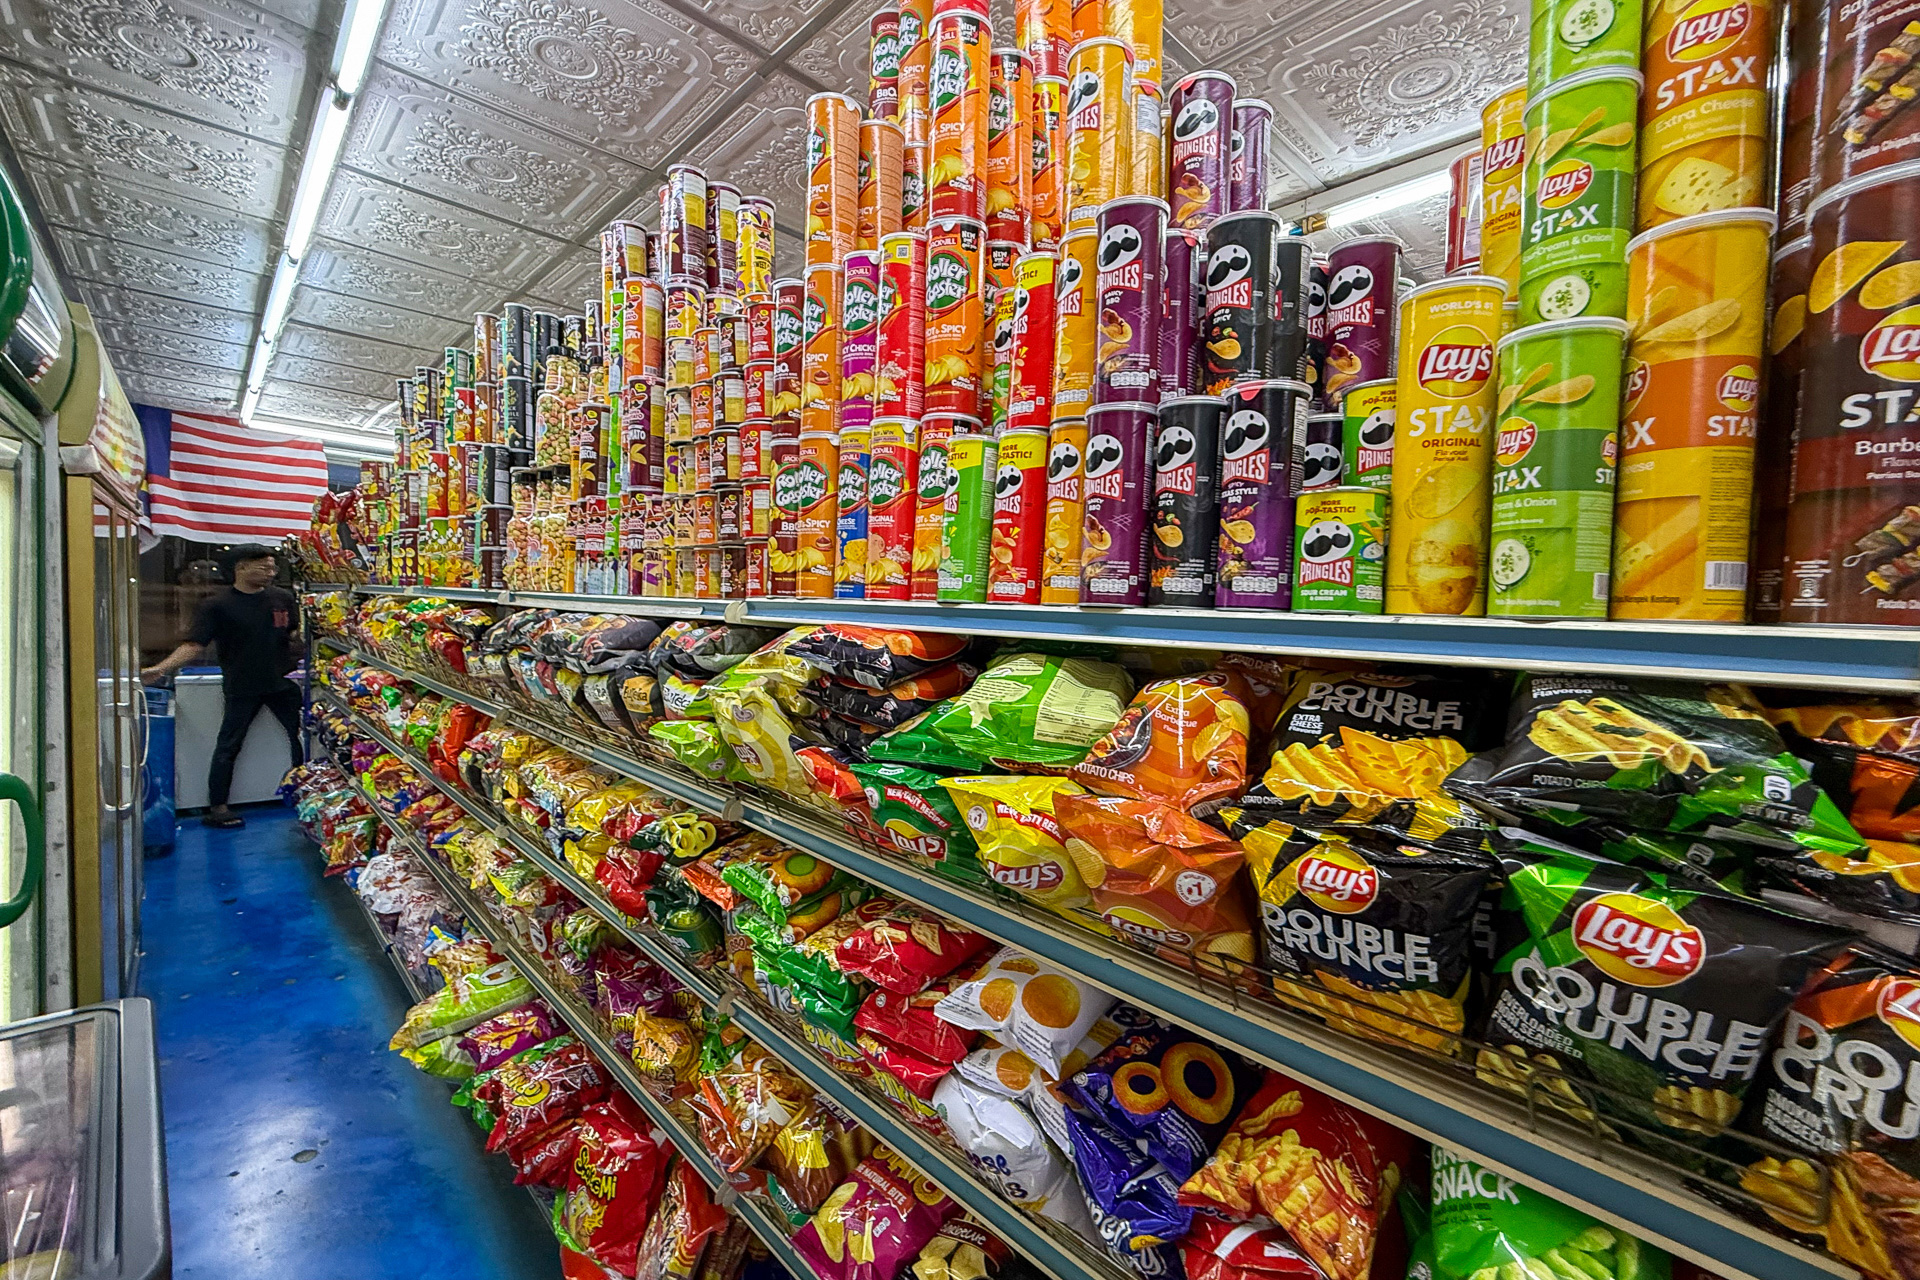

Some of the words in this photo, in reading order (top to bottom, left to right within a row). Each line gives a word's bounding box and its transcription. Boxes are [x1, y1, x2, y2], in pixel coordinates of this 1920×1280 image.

[1672, 2, 1745, 55] Lay's
[904, 65, 925, 74] SPICY
[877, 87, 897, 97] BBQ
[1656, 56, 1756, 110] STAX
[1656, 108, 1697, 132] Extra
[1701, 98, 1755, 117] Cheese
[940, 122, 965, 133] SPICY
[987, 156, 1010, 166] SPICY
[1174, 134, 1217, 167] PRINGLES
[1540, 167, 1590, 201] Lay's
[907, 225, 926, 233] SPIC
[1485, 209, 1521, 229] ORIGINA
[1531, 204, 1599, 242] STAX
[962, 230, 976, 240] NEW
[845, 286, 877, 307] oller
[1207, 282, 1249, 314] PRINGLES
[1429, 301, 1481, 313] WORLD'S
[843, 306, 876, 326] oaster
[1327, 300, 1371, 333] PRINGLES
[940, 324, 966, 335] SPICY
[806, 353, 828, 362] SPICY
[850, 344, 875, 352] CHICKE
[1422, 344, 1492, 383] Lay's
[1409, 405, 1493, 437] STAX
[1707, 415, 1756, 437] STA
[1422, 438, 1481, 448] ORIGINAL
[870, 462, 902, 482] oller
[1359, 450, 1393, 472] PRING
[800, 465, 827, 487] oller
[1515, 498, 1522, 508] &
[1524, 497, 1556, 507] Onion
[806, 518, 831, 528] SPICY
[930, 514, 944, 522] SPI
[1300, 560, 1351, 584] PRINGLES
[623, 685, 648, 702] Eureka
[1309, 682, 1461, 718] DOUBLE
[1532, 689, 1593, 699] Flavored
[1154, 708, 1198, 728] Barbecue
[1292, 713, 1321, 722] EXTRA
[1298, 696, 1463, 730] CRUNCH
[1290, 720, 1324, 729] CHEESE
[1074, 762, 1108, 779] POTATO
[1108, 769, 1135, 785] CHIPS
[1532, 774, 1573, 787] POTATO
[1302, 858, 1374, 901] Lay's
[1262, 901, 1432, 962] DOUBLE
[1578, 908, 1693, 968] Lay's
[1263, 918, 1439, 983] CRUNCH
[1501, 990, 1574, 1046] OVERLOADED
[1520, 1019, 1583, 1059] SEAWEED
[863, 1168, 890, 1192] NATURAL
[888, 1185, 907, 1206] BITE
[1433, 1164, 1521, 1205] SNACK
